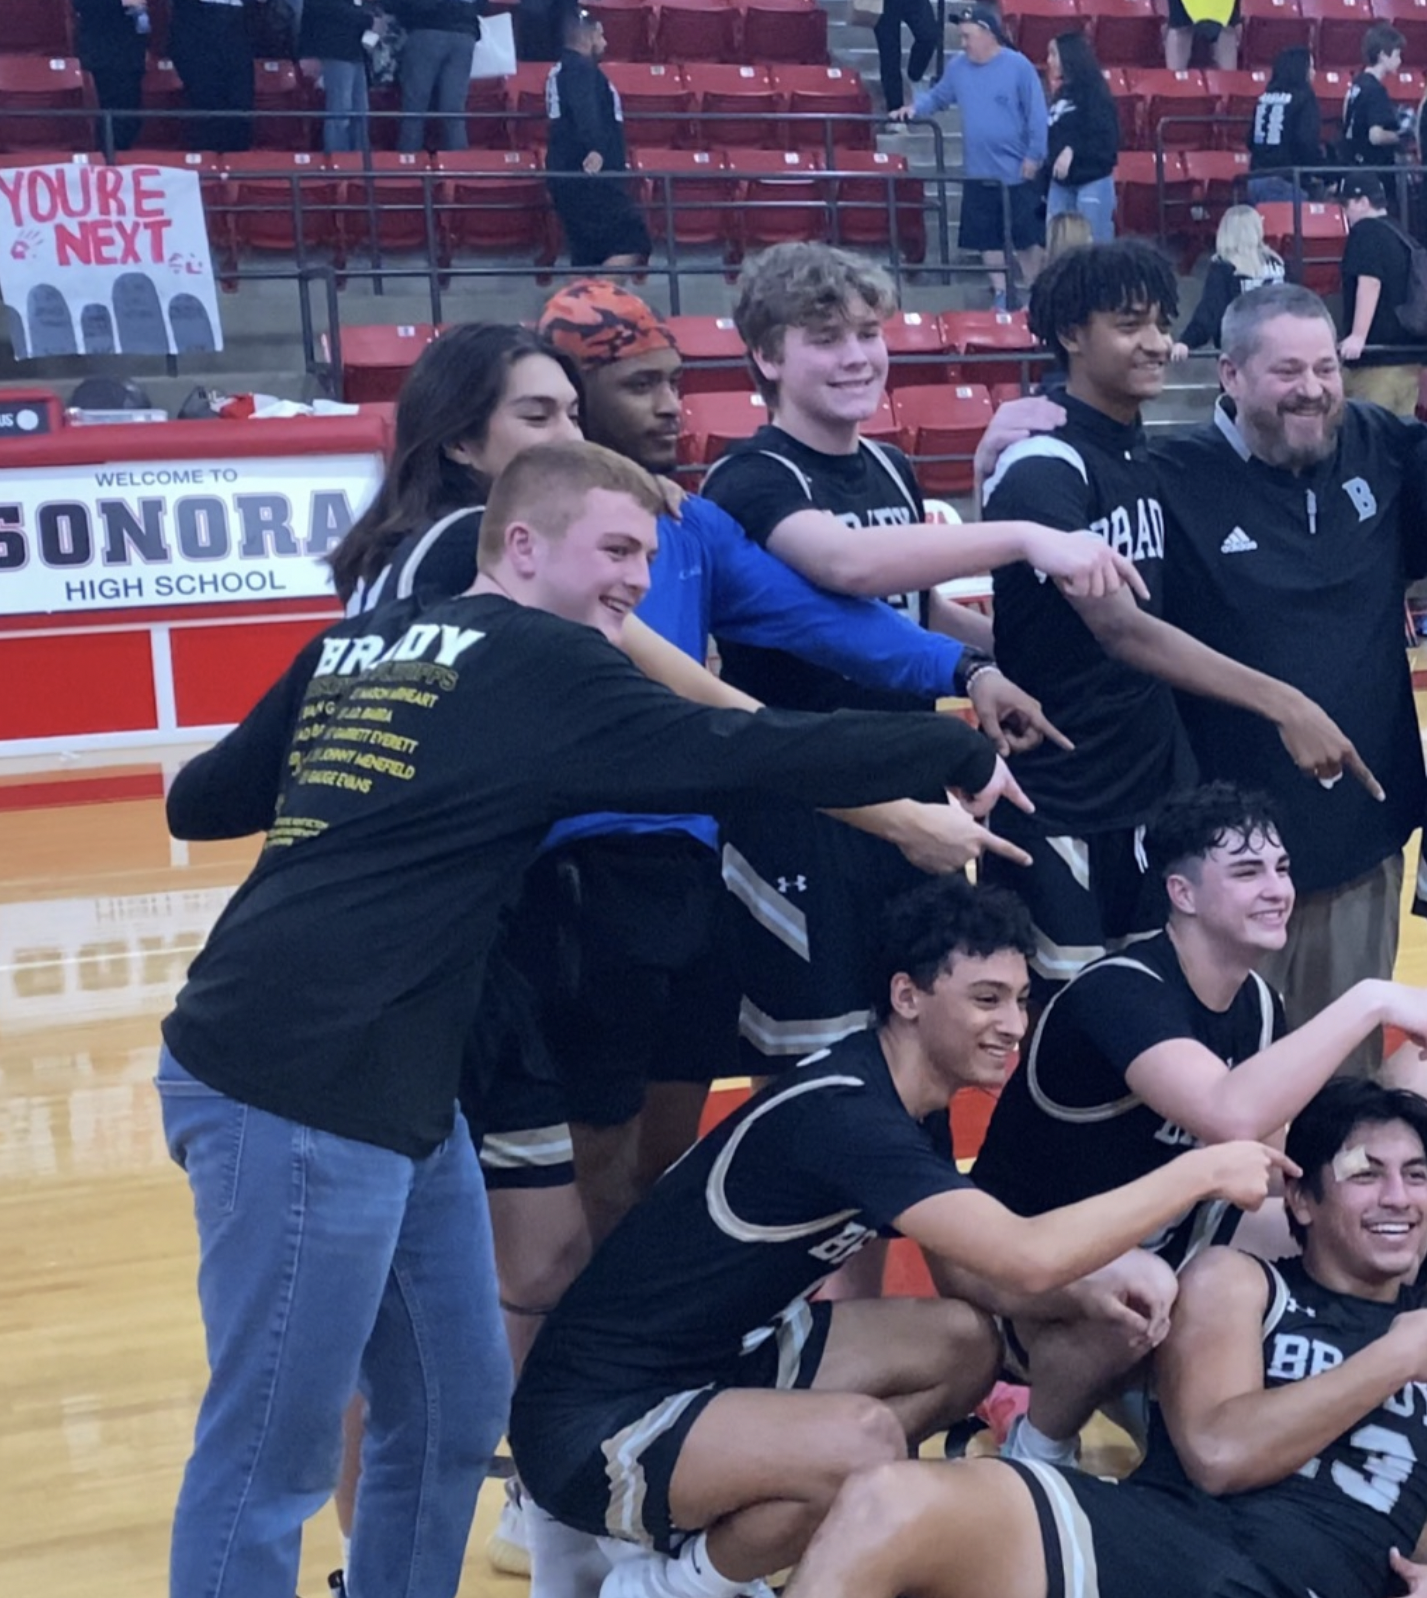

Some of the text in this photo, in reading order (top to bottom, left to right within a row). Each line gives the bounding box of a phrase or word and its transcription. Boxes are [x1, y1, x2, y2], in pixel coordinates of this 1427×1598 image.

[54, 219, 172, 266] NEXT
[95, 468, 238, 487] WELCOME TO
[1342, 476, 1377, 522] B
[0, 488, 355, 572] SONORA
[65, 570, 287, 601] HIGH SCHOOL
